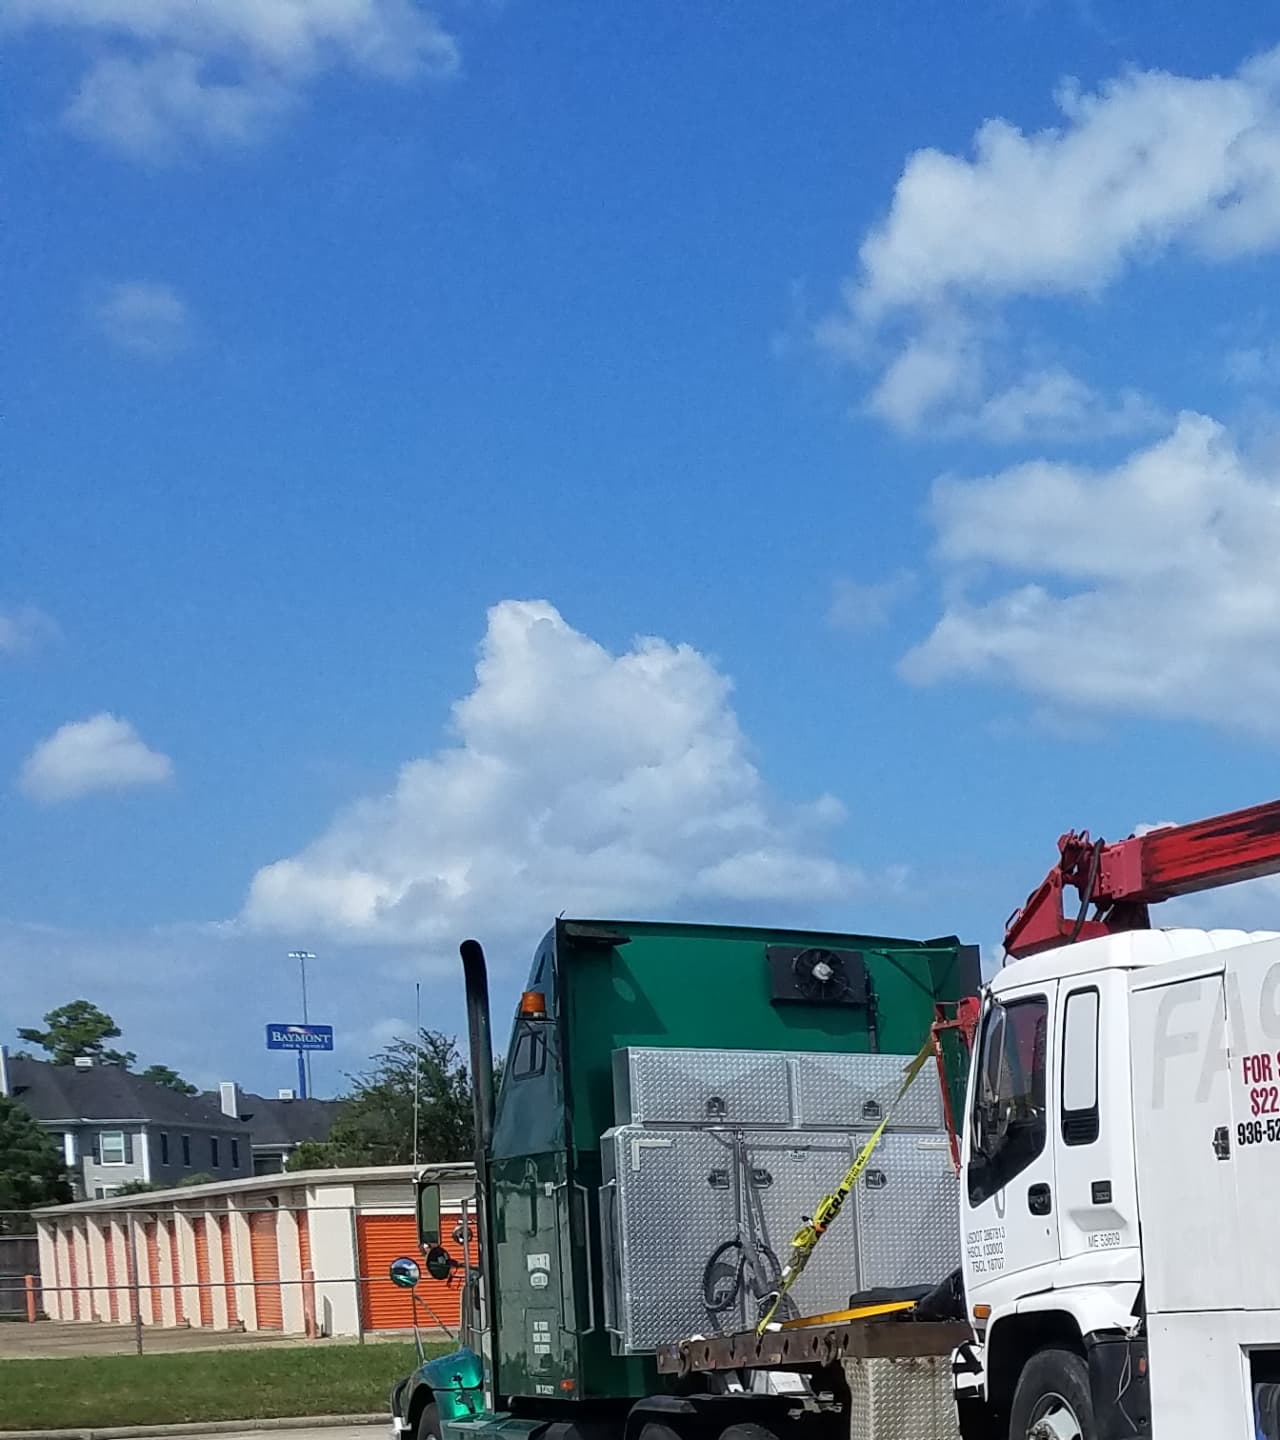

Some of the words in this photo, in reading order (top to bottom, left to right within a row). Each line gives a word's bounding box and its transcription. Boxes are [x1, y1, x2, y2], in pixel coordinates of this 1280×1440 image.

[271, 1031, 331, 1043] BAYMONT
[1243, 1053, 1273, 1085] FOR
[1100, 1232, 1121, 1246] 53609
